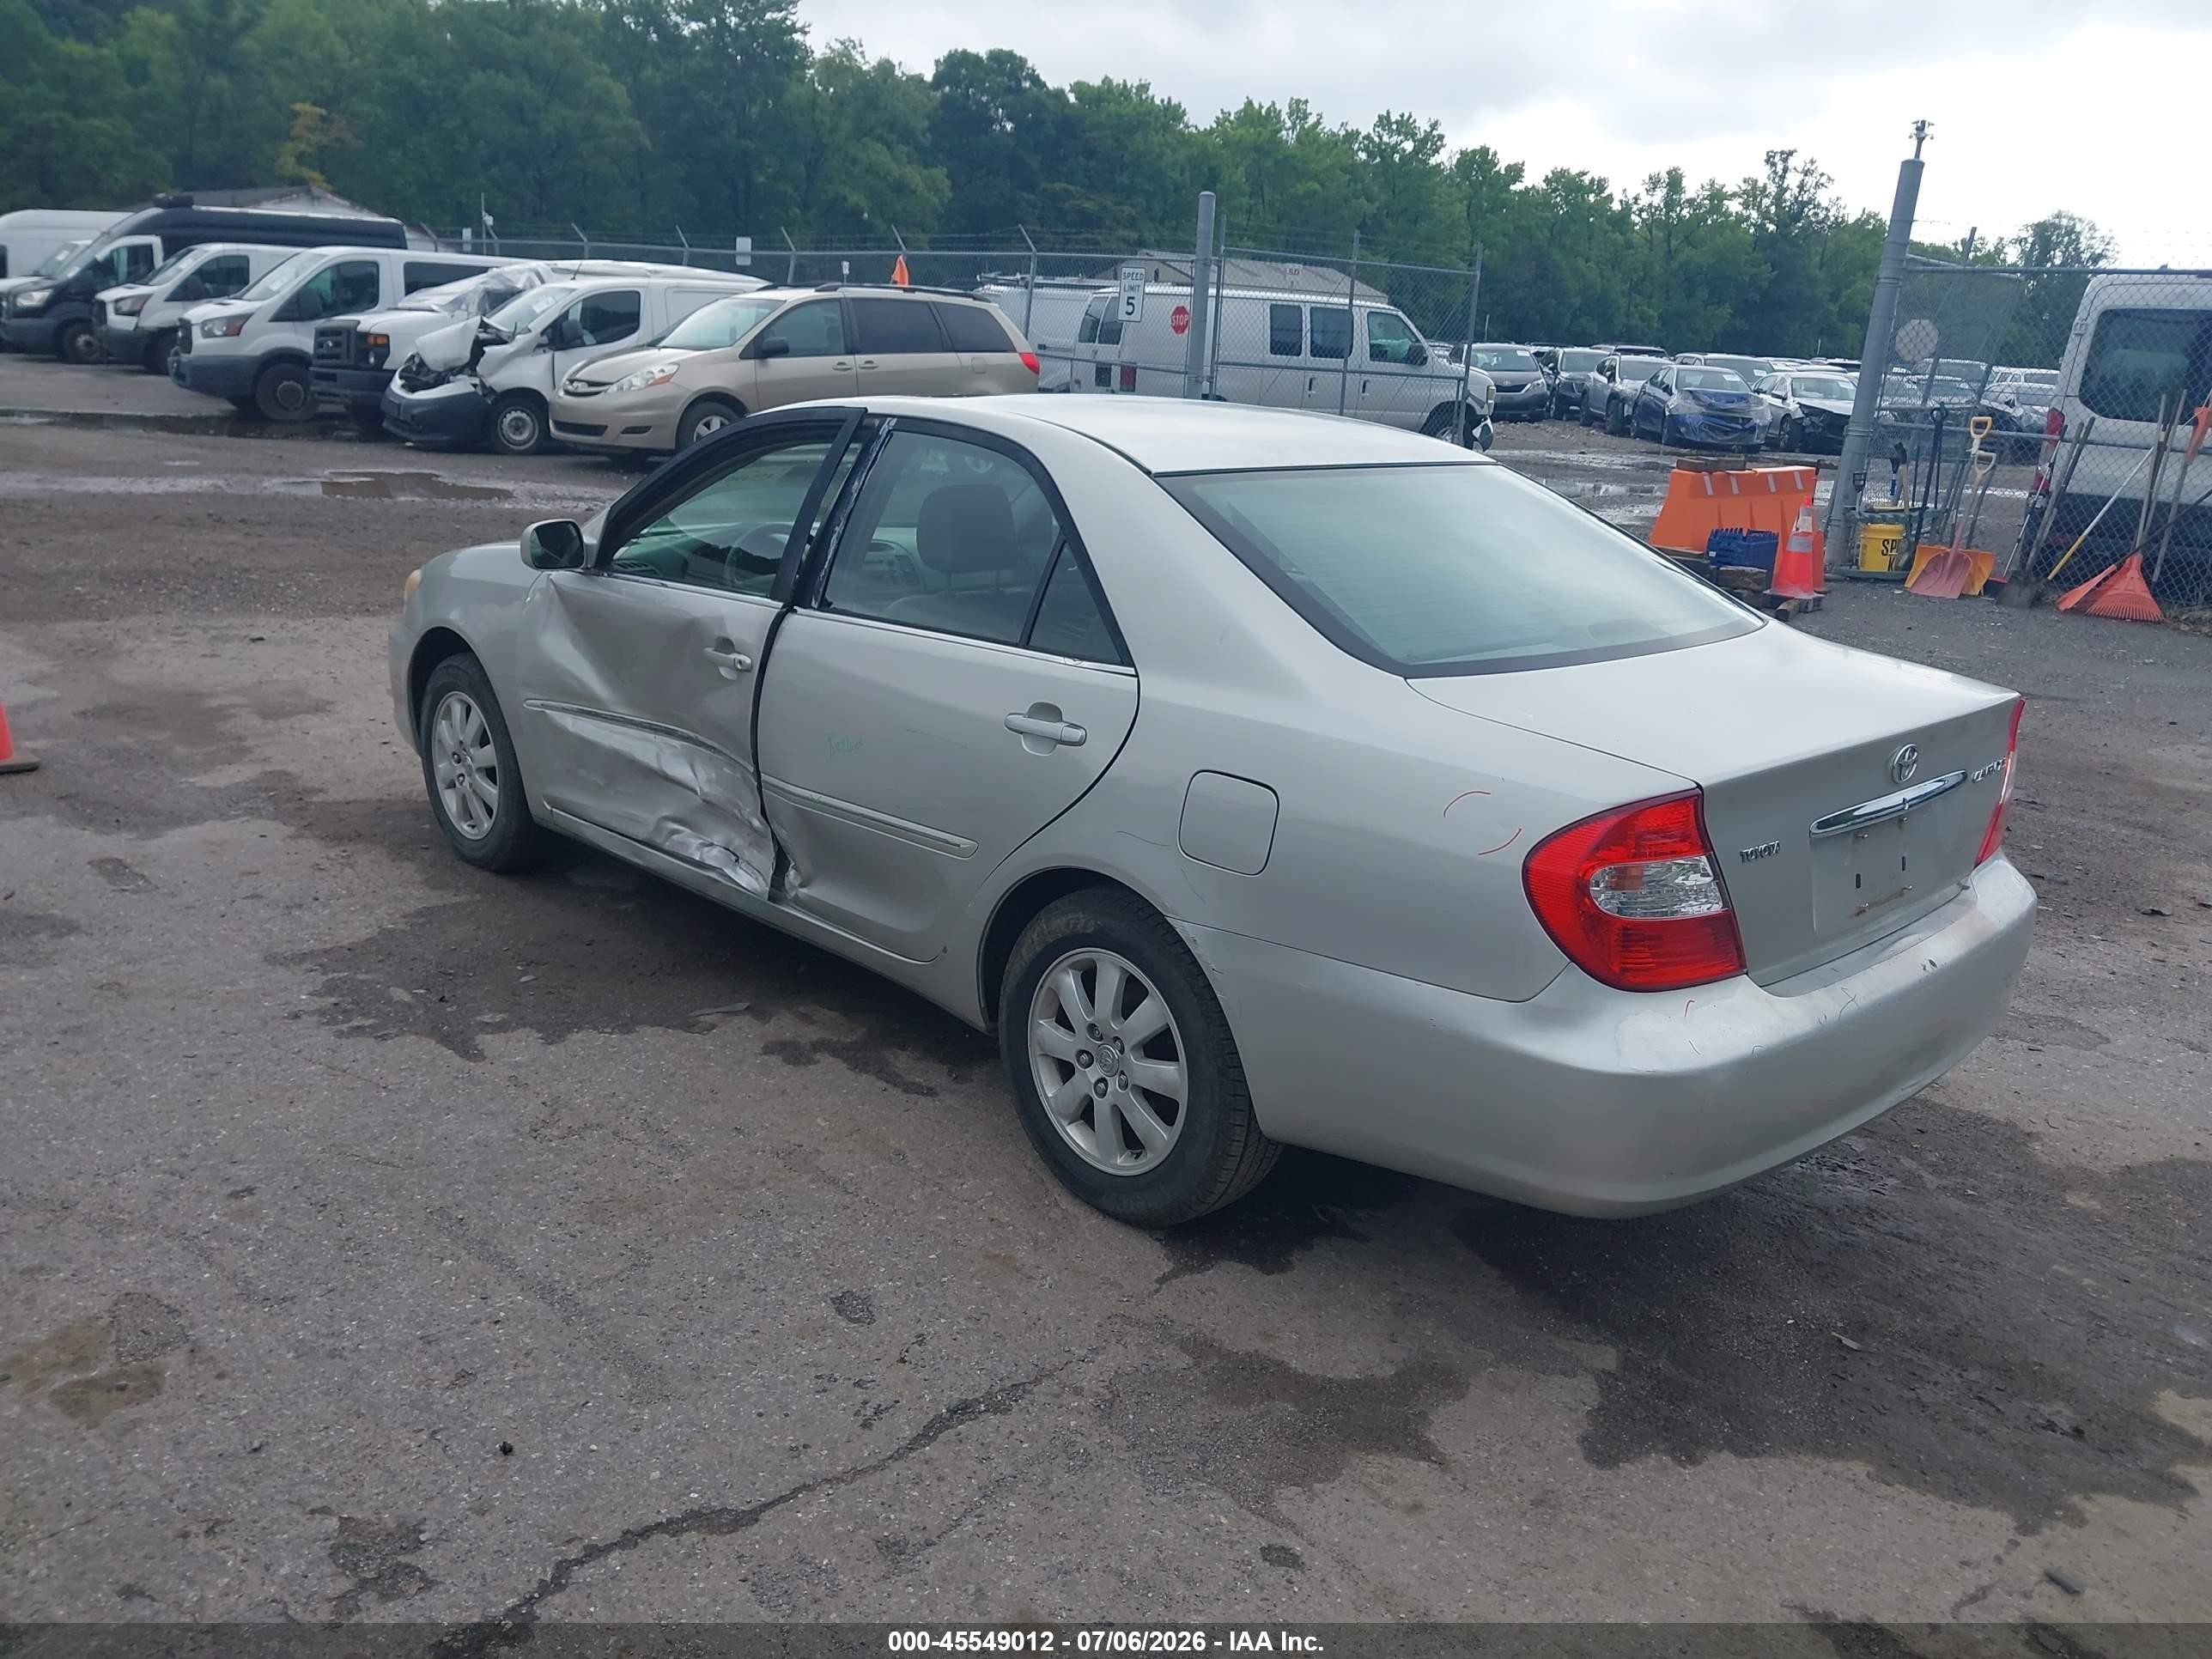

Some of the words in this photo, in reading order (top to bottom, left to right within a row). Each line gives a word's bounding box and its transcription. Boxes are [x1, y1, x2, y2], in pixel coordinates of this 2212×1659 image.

[1122, 271, 1144, 281] SPEED
[1123, 284, 1141, 293] LIMIT
[1125, 296, 1135, 315] 5
[1171, 314, 1188, 326] STOP
[1740, 840, 1780, 864] TOYOTA
